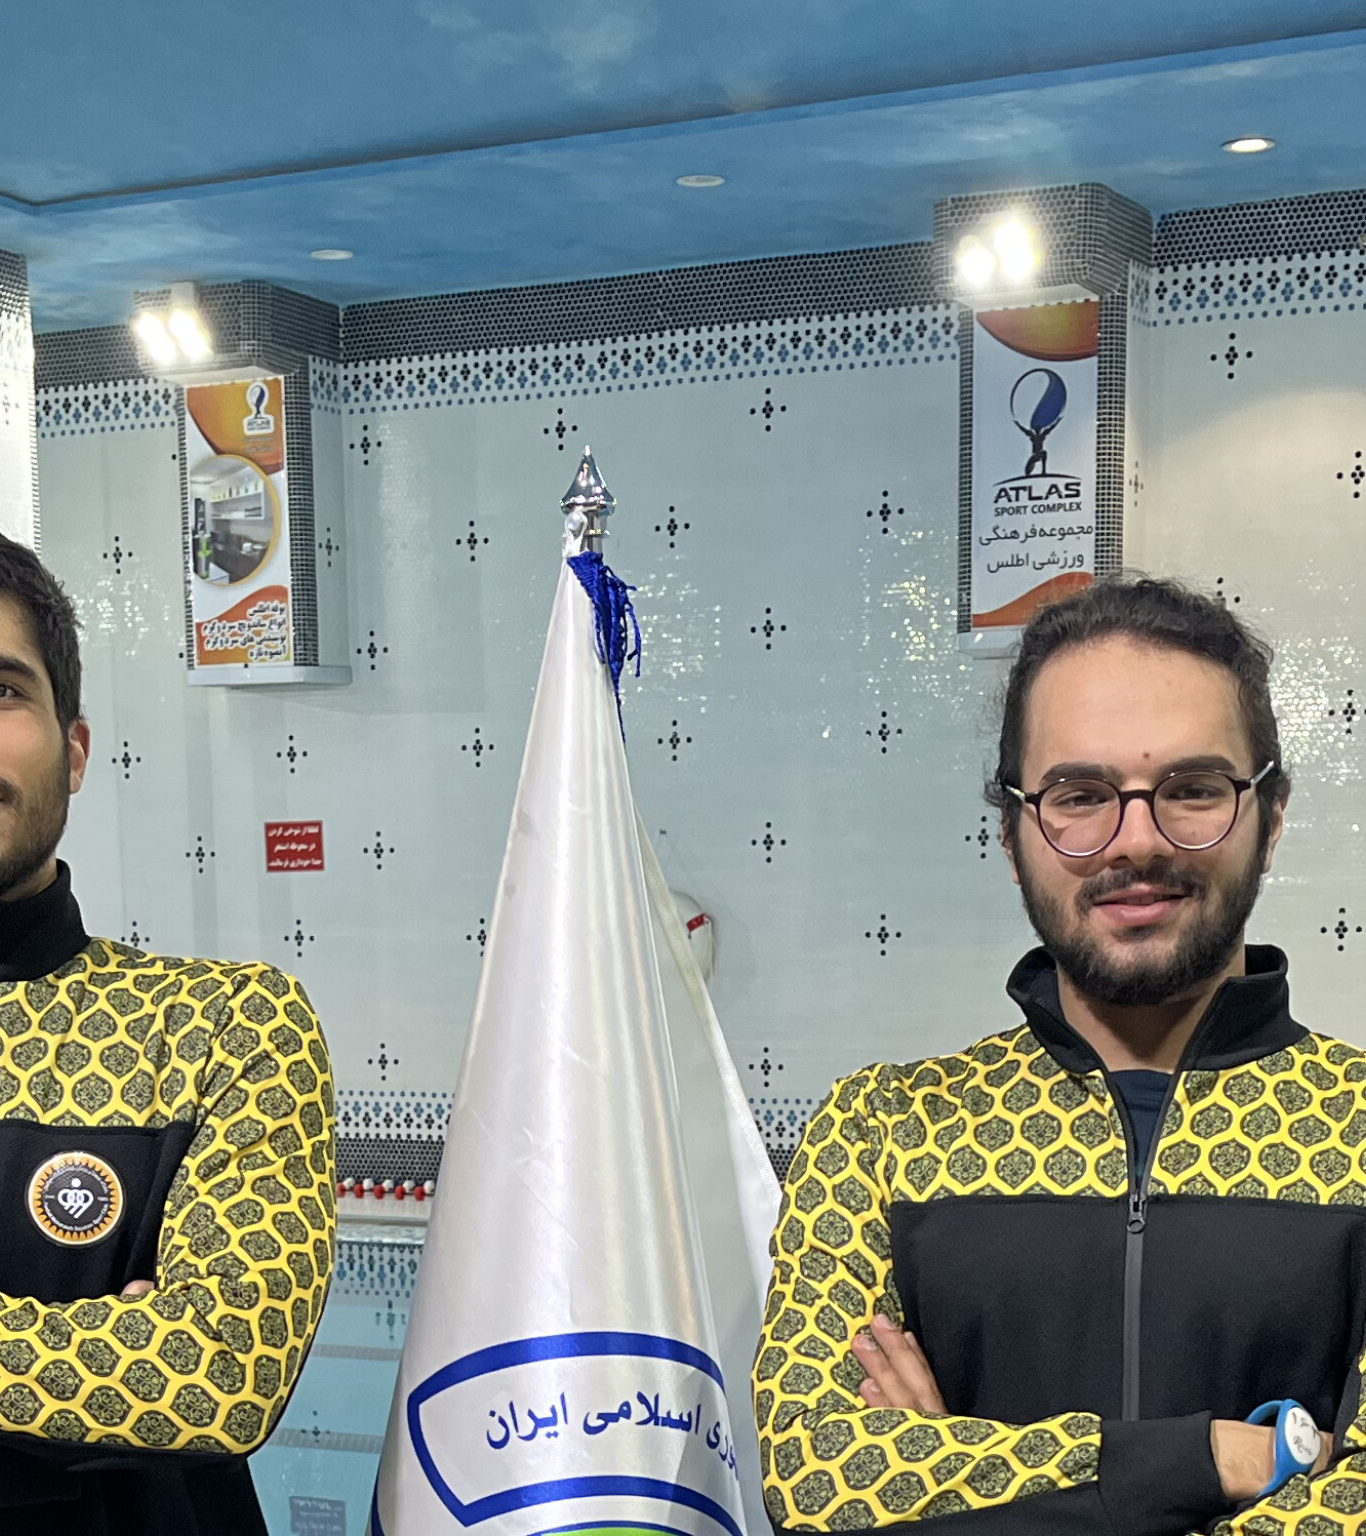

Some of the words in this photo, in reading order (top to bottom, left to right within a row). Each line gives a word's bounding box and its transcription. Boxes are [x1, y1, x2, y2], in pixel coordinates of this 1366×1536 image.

[993, 482, 1082, 504] ATLAS
[995, 505, 1029, 517] SPORT
[1031, 502, 1082, 514] COMPLEX
[978, 523, 1038, 546] فرهنگی
[1038, 525, 1094, 541] مجموعه
[987, 552, 1029, 574] اطلس
[1032, 550, 1084, 571] ورزشی
[486, 1392, 569, 1450] ایران
[583, 1391, 702, 1436] اسلامی
